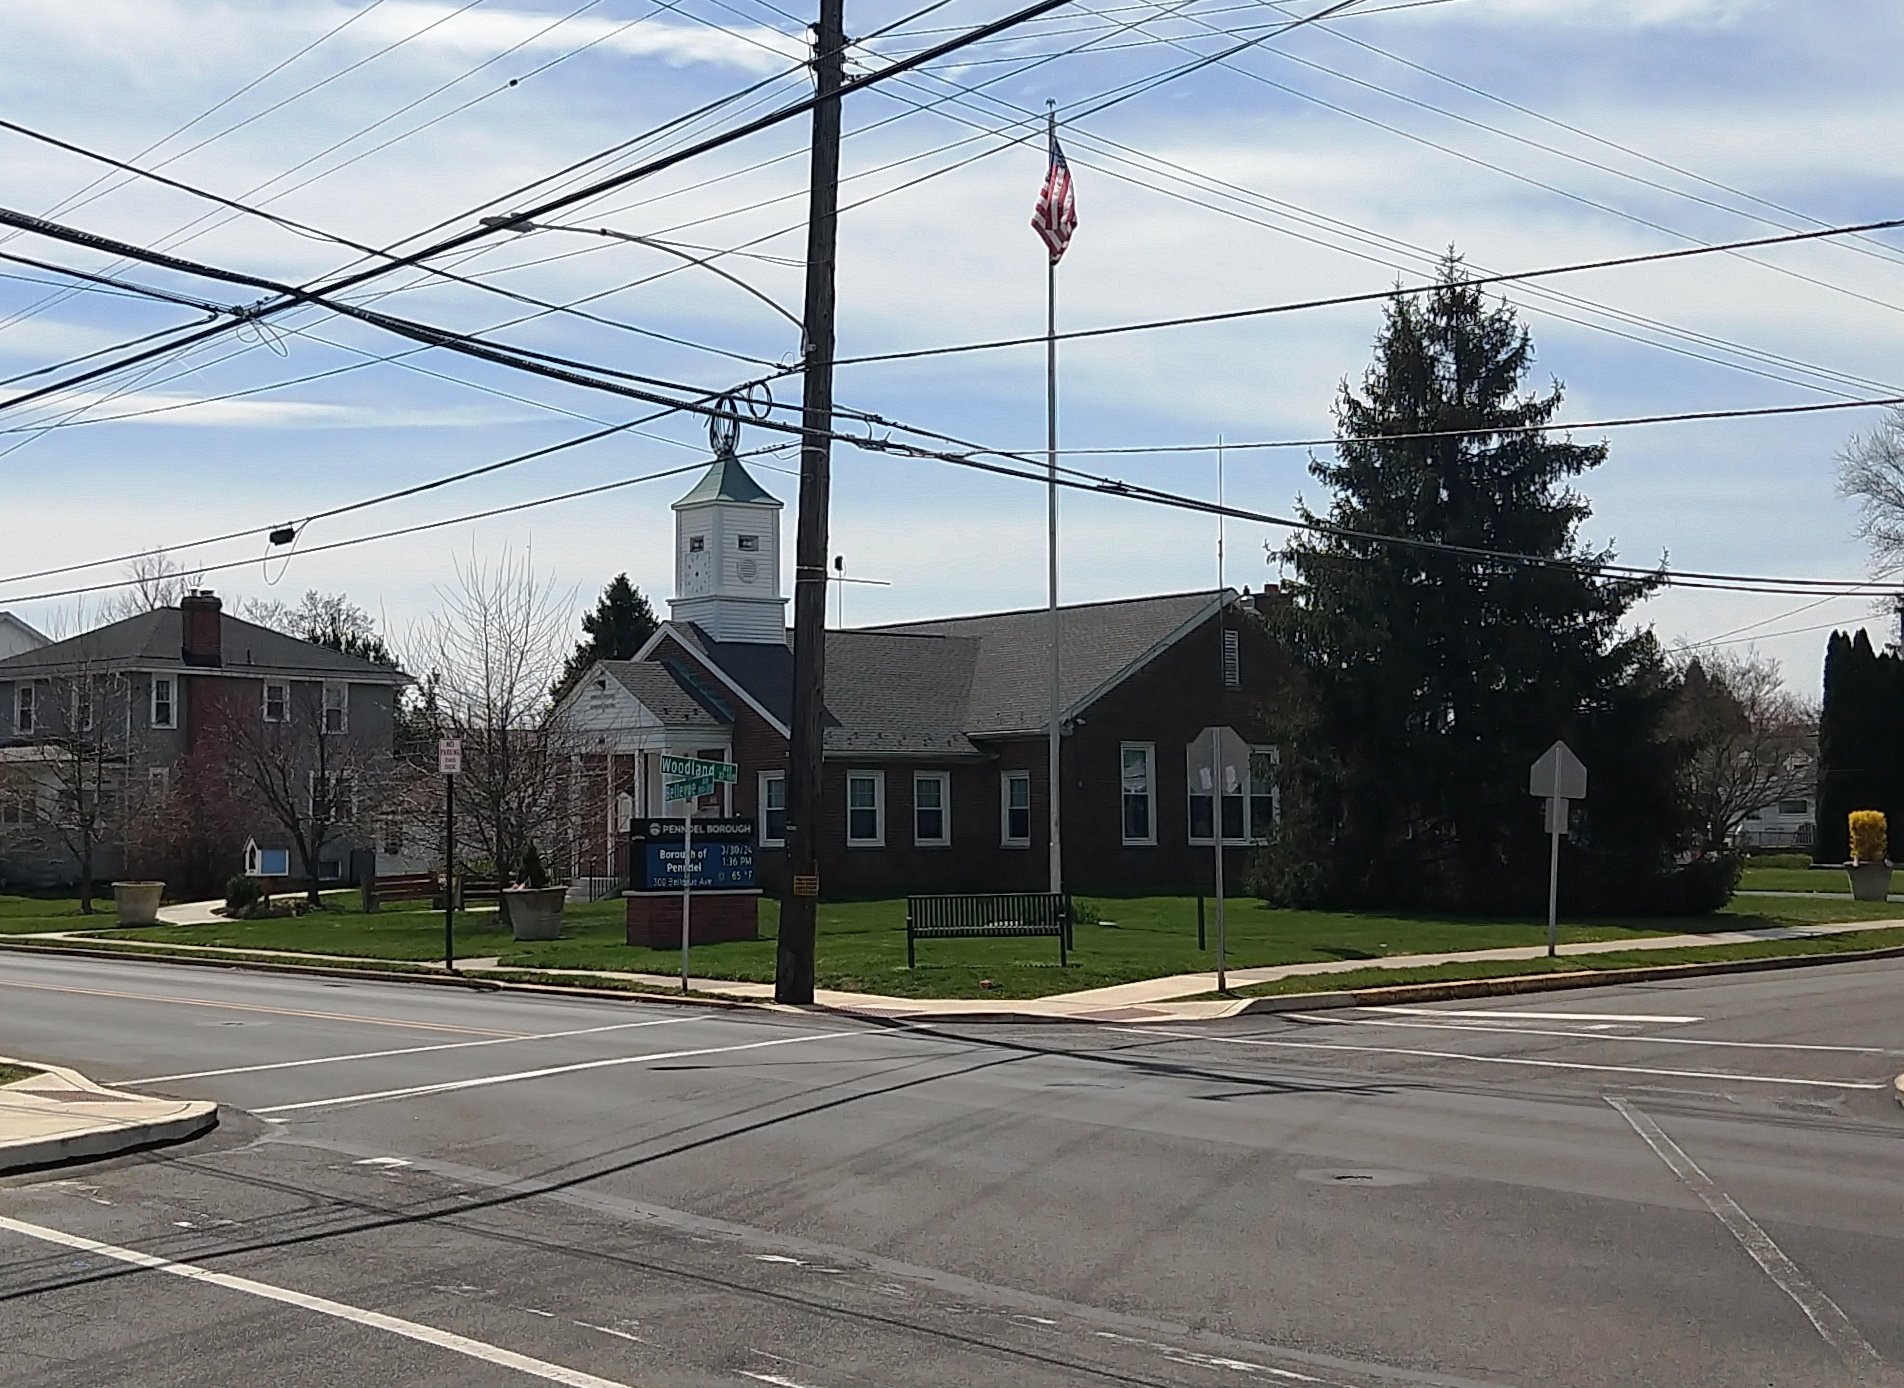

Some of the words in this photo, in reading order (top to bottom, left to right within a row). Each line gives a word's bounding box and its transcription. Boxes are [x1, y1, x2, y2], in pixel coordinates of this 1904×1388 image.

[662, 757, 715, 776] Woodland
[706, 824, 751, 834] BOROUGH
[659, 849, 696, 860] Borouh
[697, 847, 708, 859] of
[722, 856, 738, 867] 1:36
[740, 856, 752, 866] PM
[731, 871, 742, 881] 65
